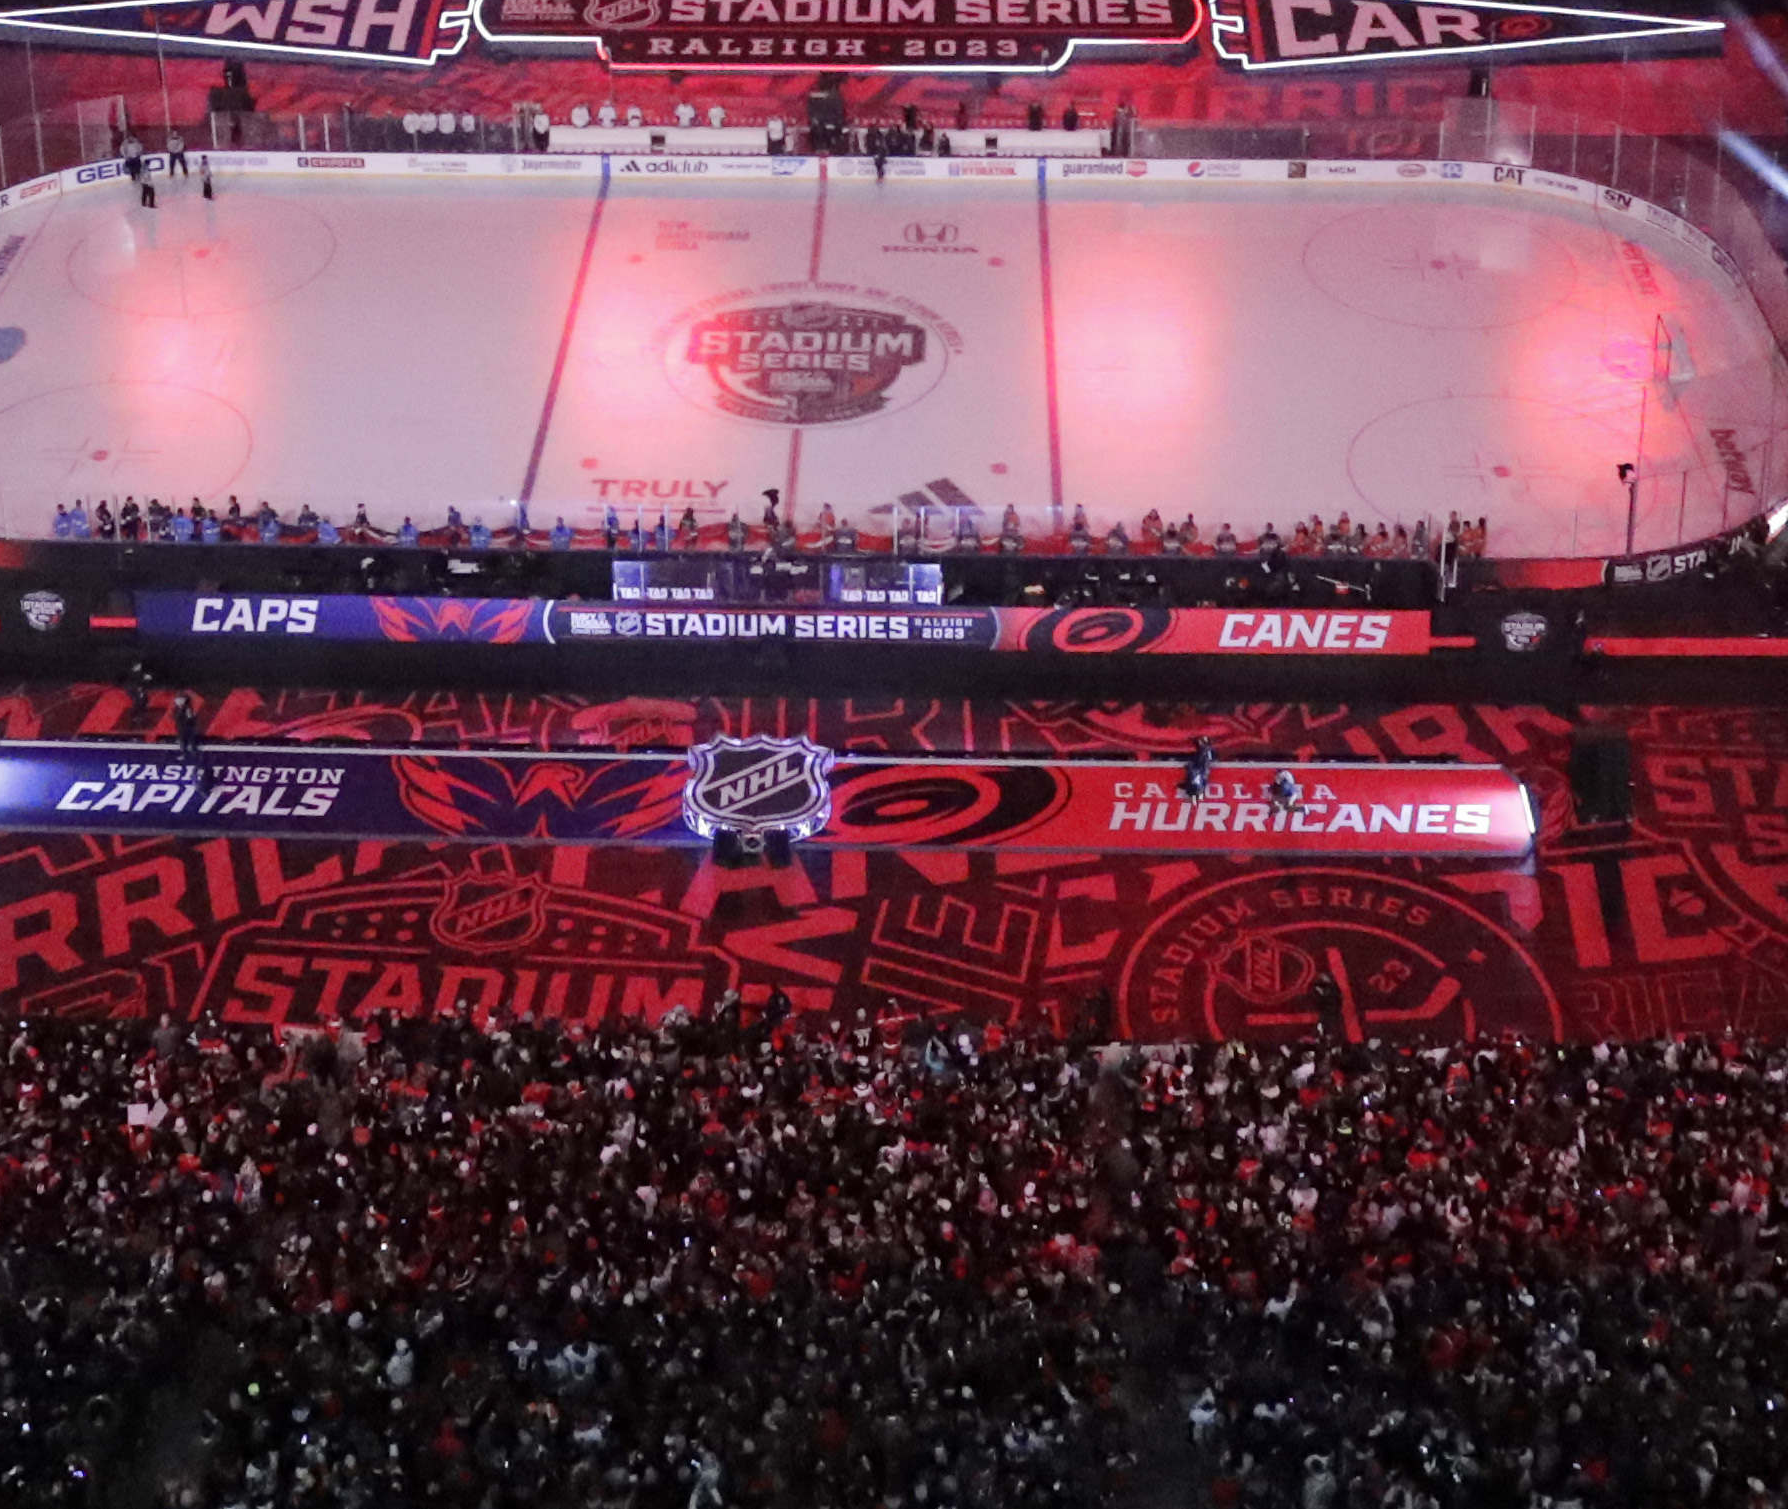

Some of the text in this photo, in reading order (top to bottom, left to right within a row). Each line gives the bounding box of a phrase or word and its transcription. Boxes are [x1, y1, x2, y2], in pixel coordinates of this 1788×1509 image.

[647, 38, 1019, 57] RALEIGH 2023
[76, 156, 165, 184] GEIO
[645, 159, 708, 173] adiclub
[1063, 162, 1123, 177] guaranteed
[1494, 166, 1526, 185] CAT
[19, 179, 58, 200] ESPN
[882, 245, 979, 254] HONDA
[701, 332, 913, 357] STADIUM
[738, 353, 871, 372] SERIES
[591, 479, 730, 500] TRULY
[193, 597, 318, 633] CAPS
[646, 614, 909, 639] STADIUM SERIES
[914, 618, 974, 627] RALEIGH
[921, 627, 964, 640] 2023
[1219, 613, 1391, 648] CANES
[717, 760, 801, 808] NHL
[57, 782, 343, 817] CAPITALS
[1108, 801, 1492, 833] HURRICANES
[455, 893, 530, 932] NHL
[1149, 887, 1431, 1025] STADIUM SERIES
